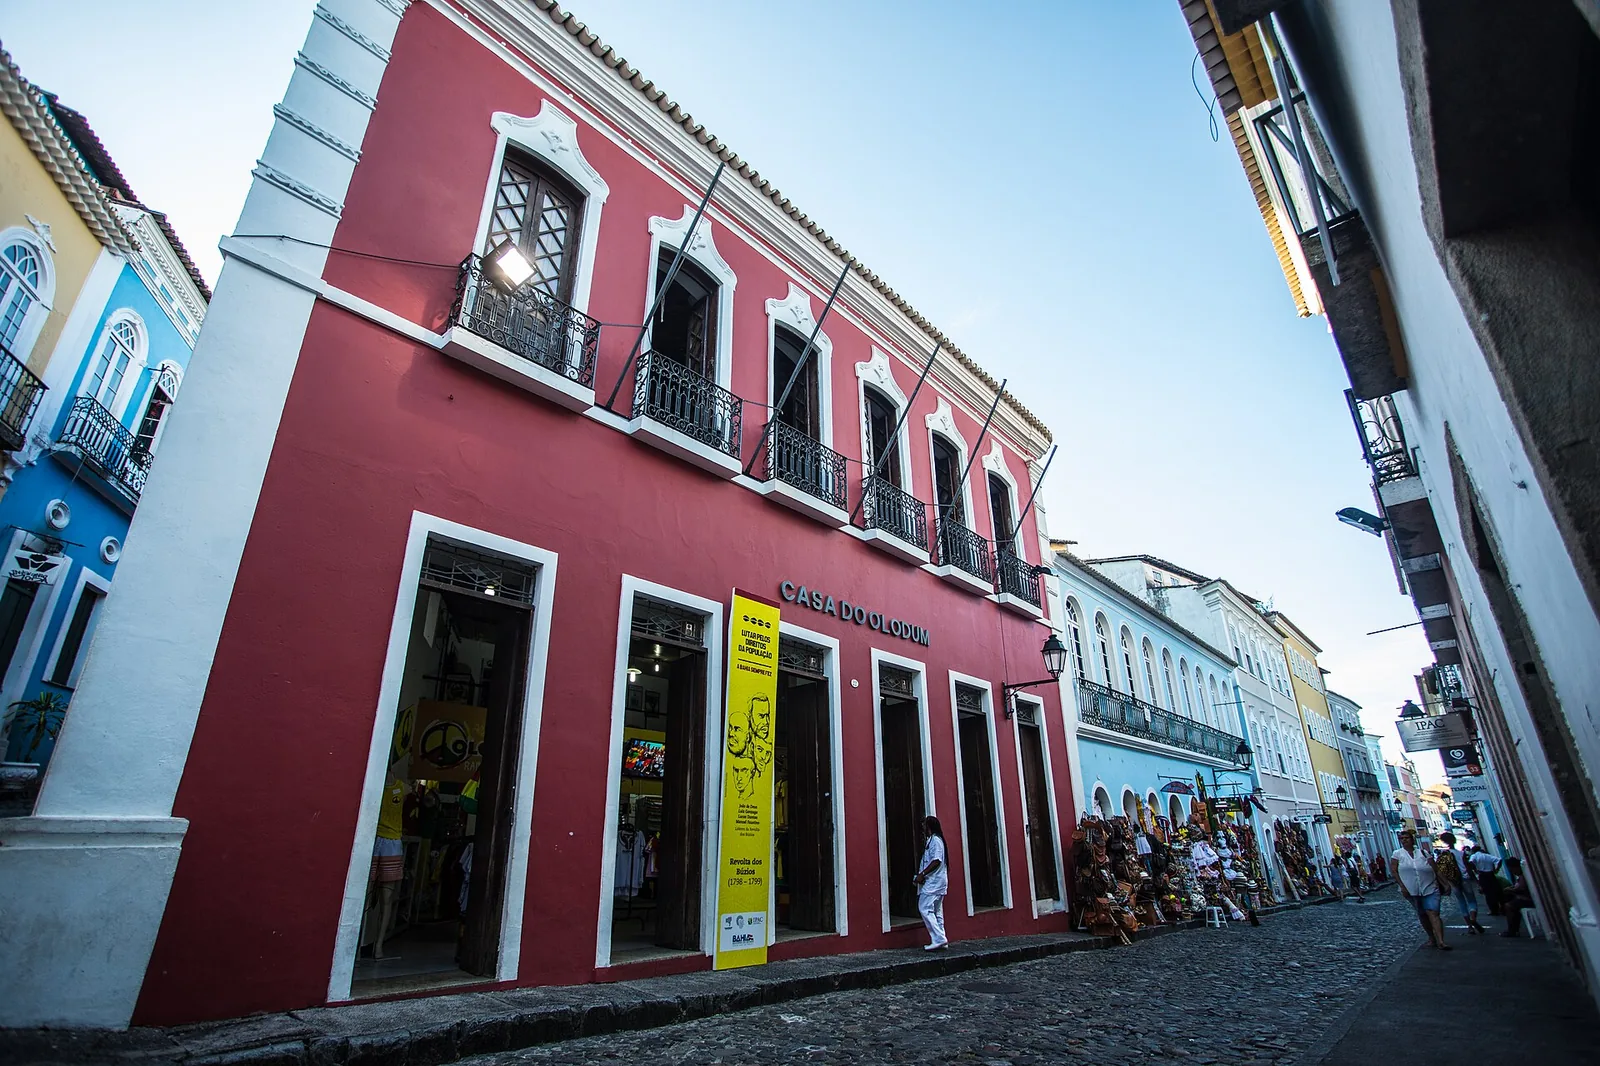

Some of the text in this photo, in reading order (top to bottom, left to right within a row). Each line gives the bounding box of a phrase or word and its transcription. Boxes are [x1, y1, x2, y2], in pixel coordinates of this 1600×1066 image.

[780, 580, 930, 647] CASA DO OLODUM
[742, 630, 771, 643] LUTAR PELOS
[745, 639, 766, 649] DIREITOS
[738, 644, 772, 659] DA POPULAÇÃO
[1415, 718, 1446, 731] IPAC
[729, 858, 763, 866] Revolta dos
